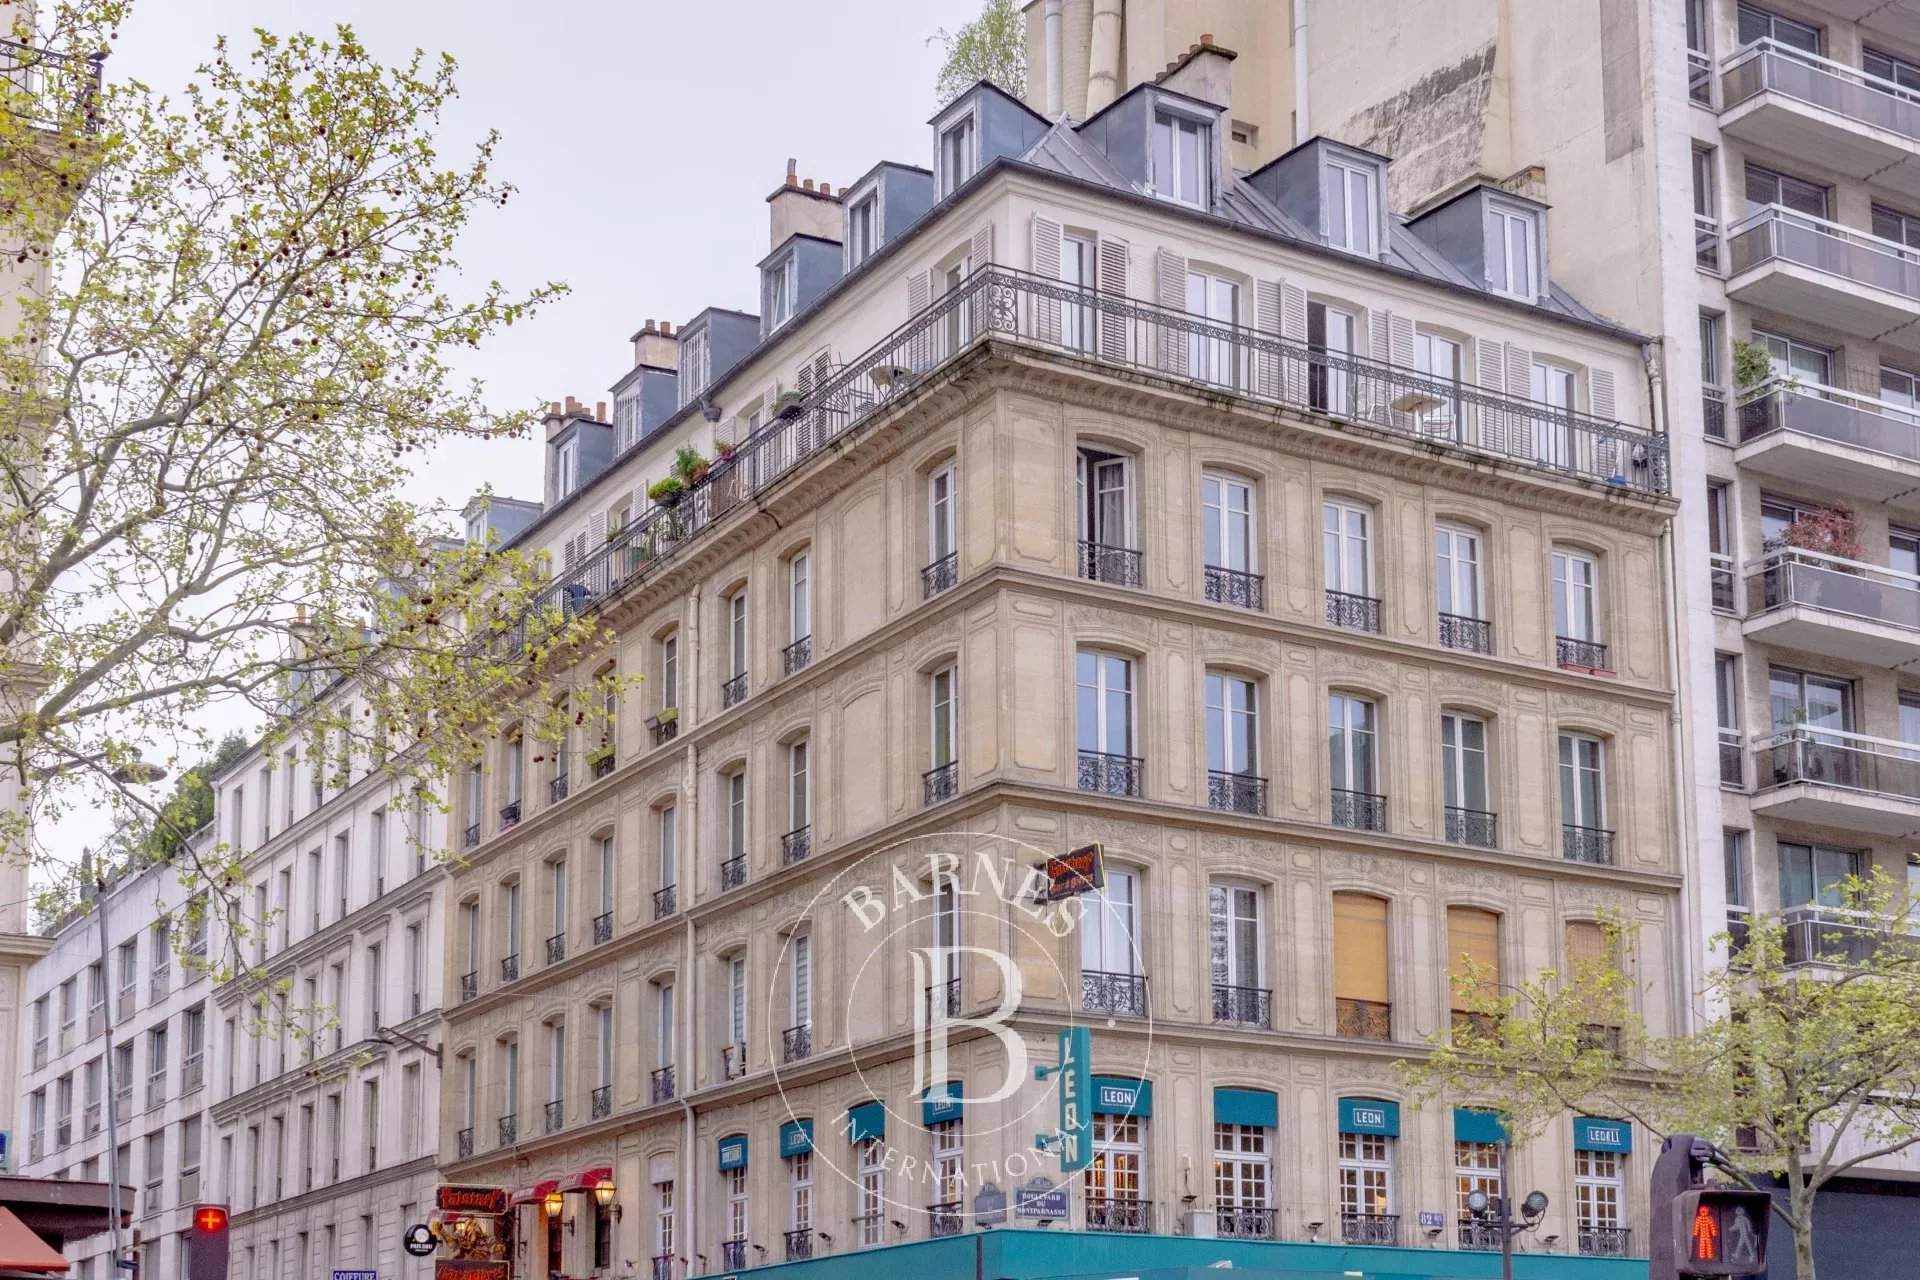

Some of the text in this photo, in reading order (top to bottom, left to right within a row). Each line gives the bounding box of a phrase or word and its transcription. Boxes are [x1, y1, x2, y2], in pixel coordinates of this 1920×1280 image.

[1104, 1090, 1132, 1104] LEON
[1356, 1111, 1381, 1124] LEON
[1017, 1208, 1065, 1216] MONTPARNASSE
